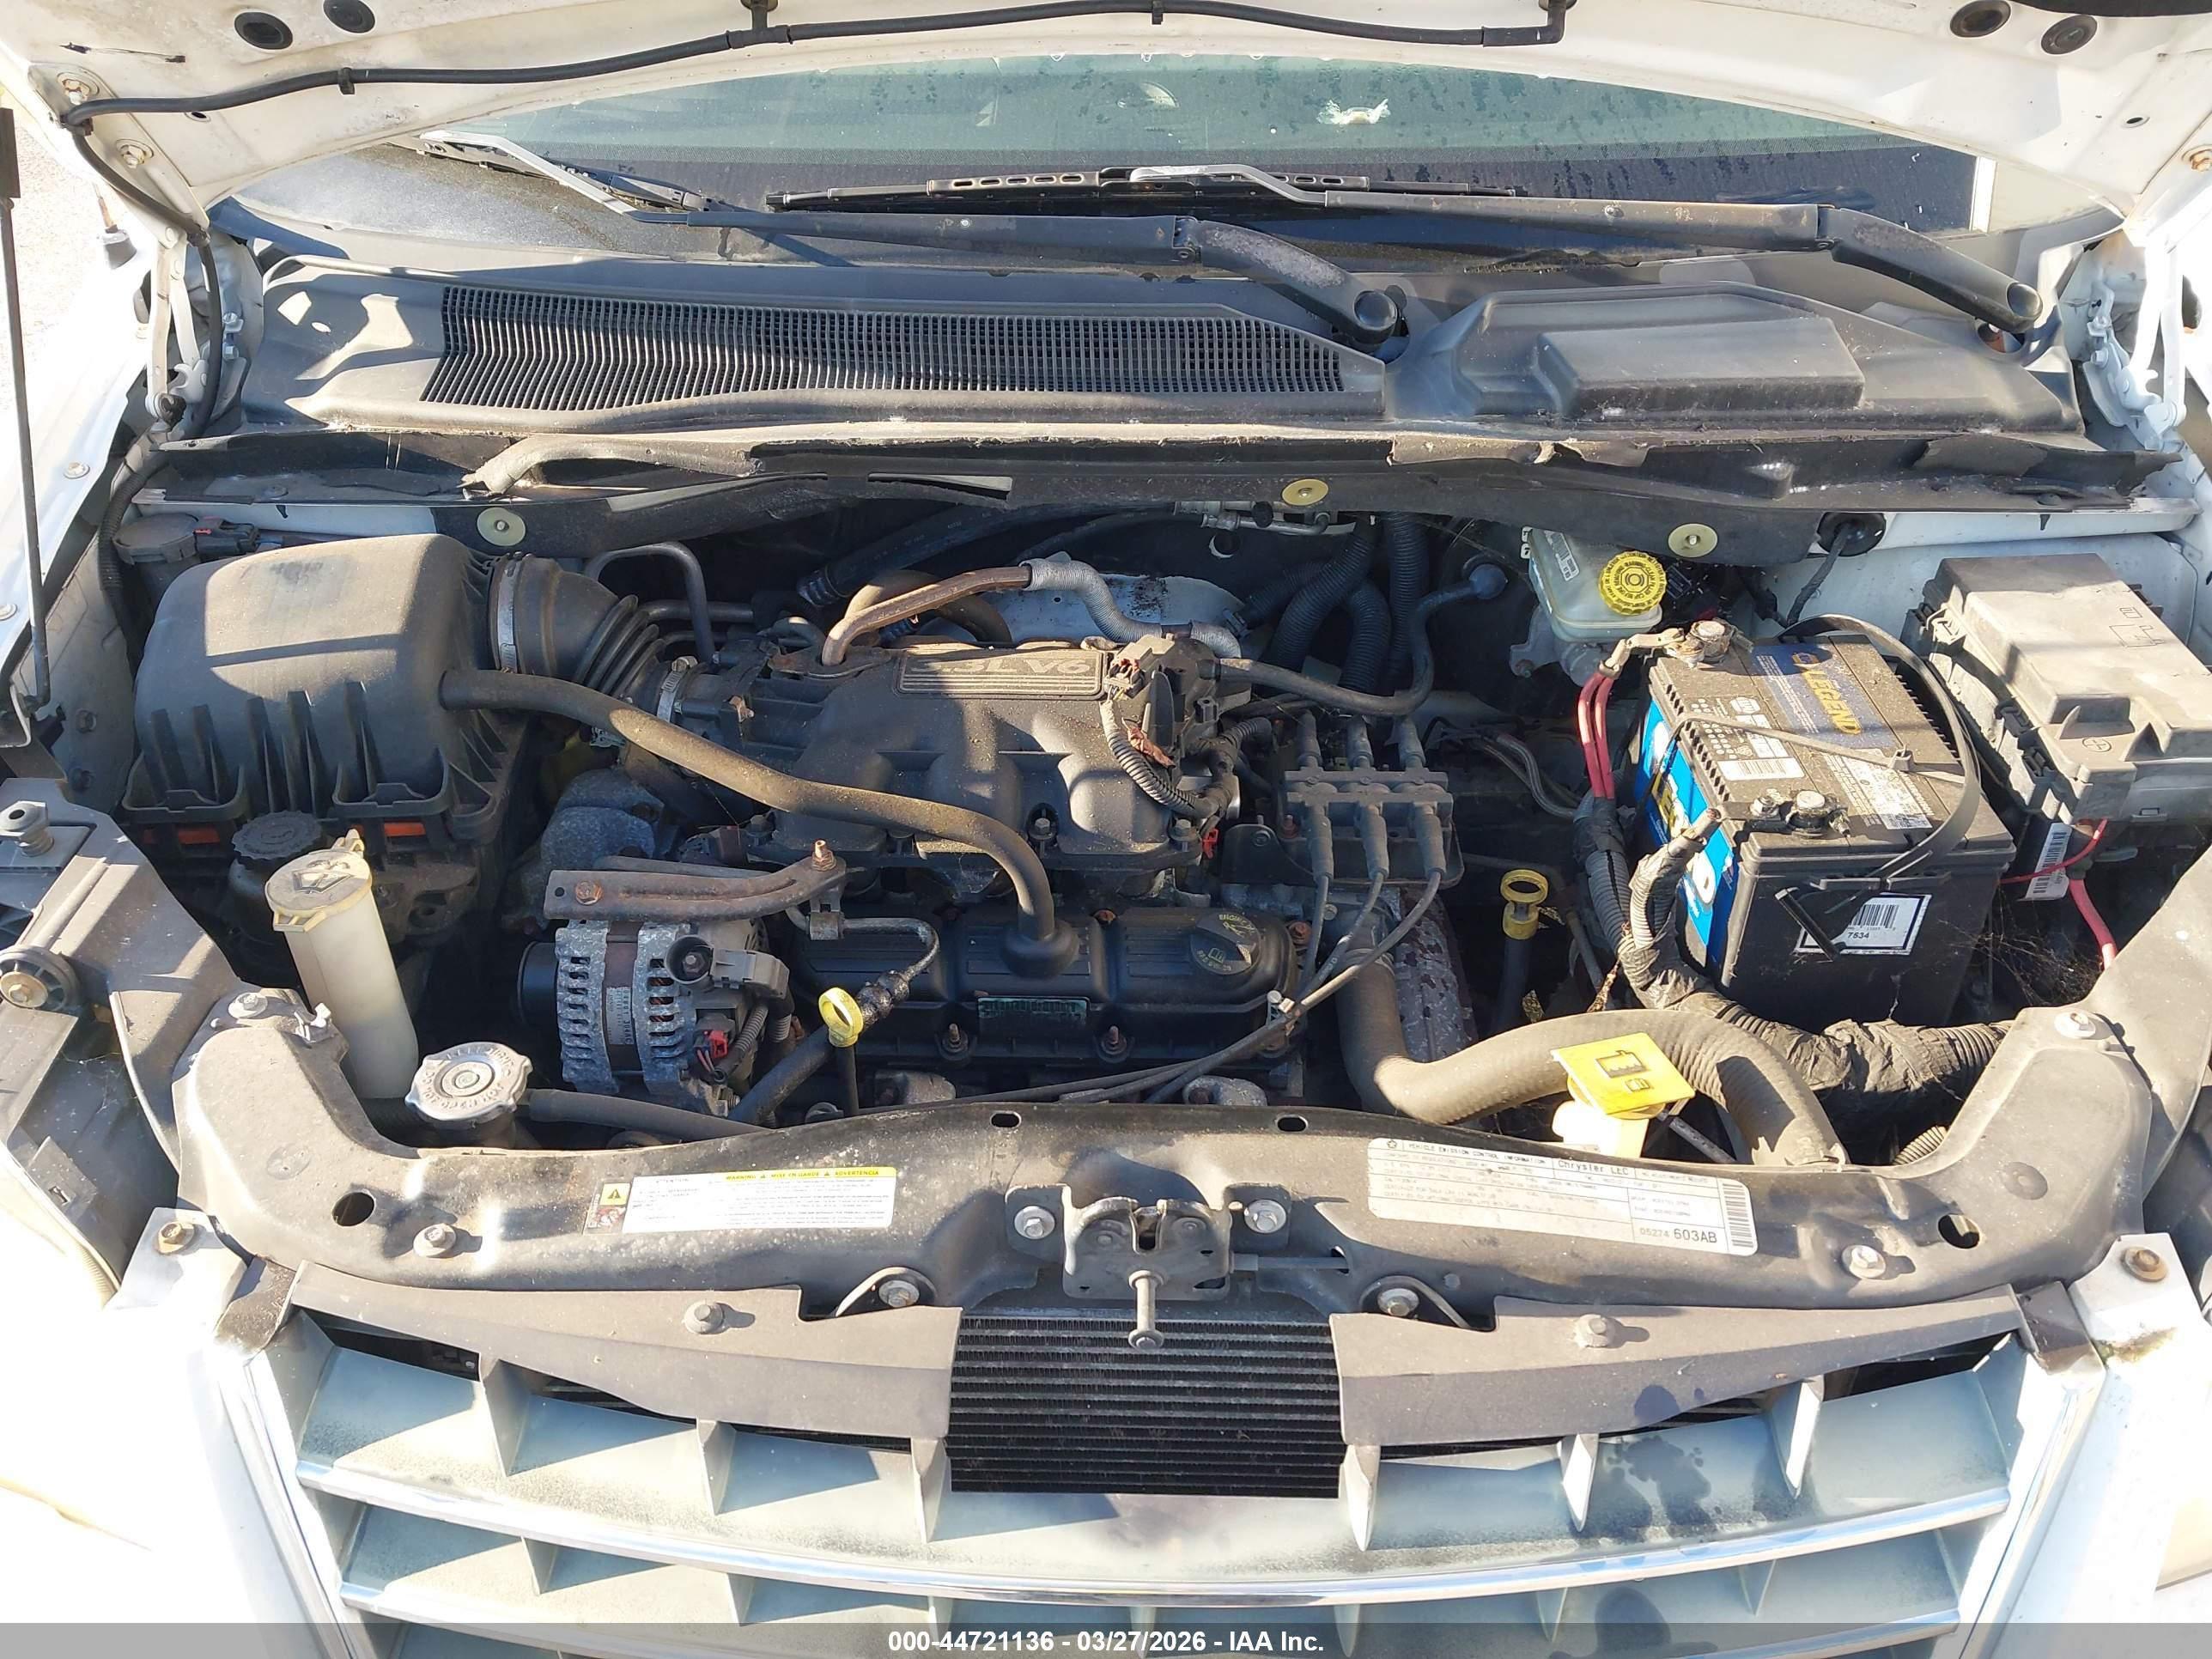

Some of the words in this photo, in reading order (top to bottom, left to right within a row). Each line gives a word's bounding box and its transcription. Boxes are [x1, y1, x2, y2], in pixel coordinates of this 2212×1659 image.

[1026, 659, 1090, 673] V6
[1802, 669, 1863, 735] LEGEND
[1473, 1150, 1499, 1159] CONTROL
[1558, 1160, 1604, 1174] Chrysler
[1610, 1165, 1629, 1176] LLC
[1639, 1227, 1670, 1238] 05274
[1674, 1229, 1717, 1243] 603AB
